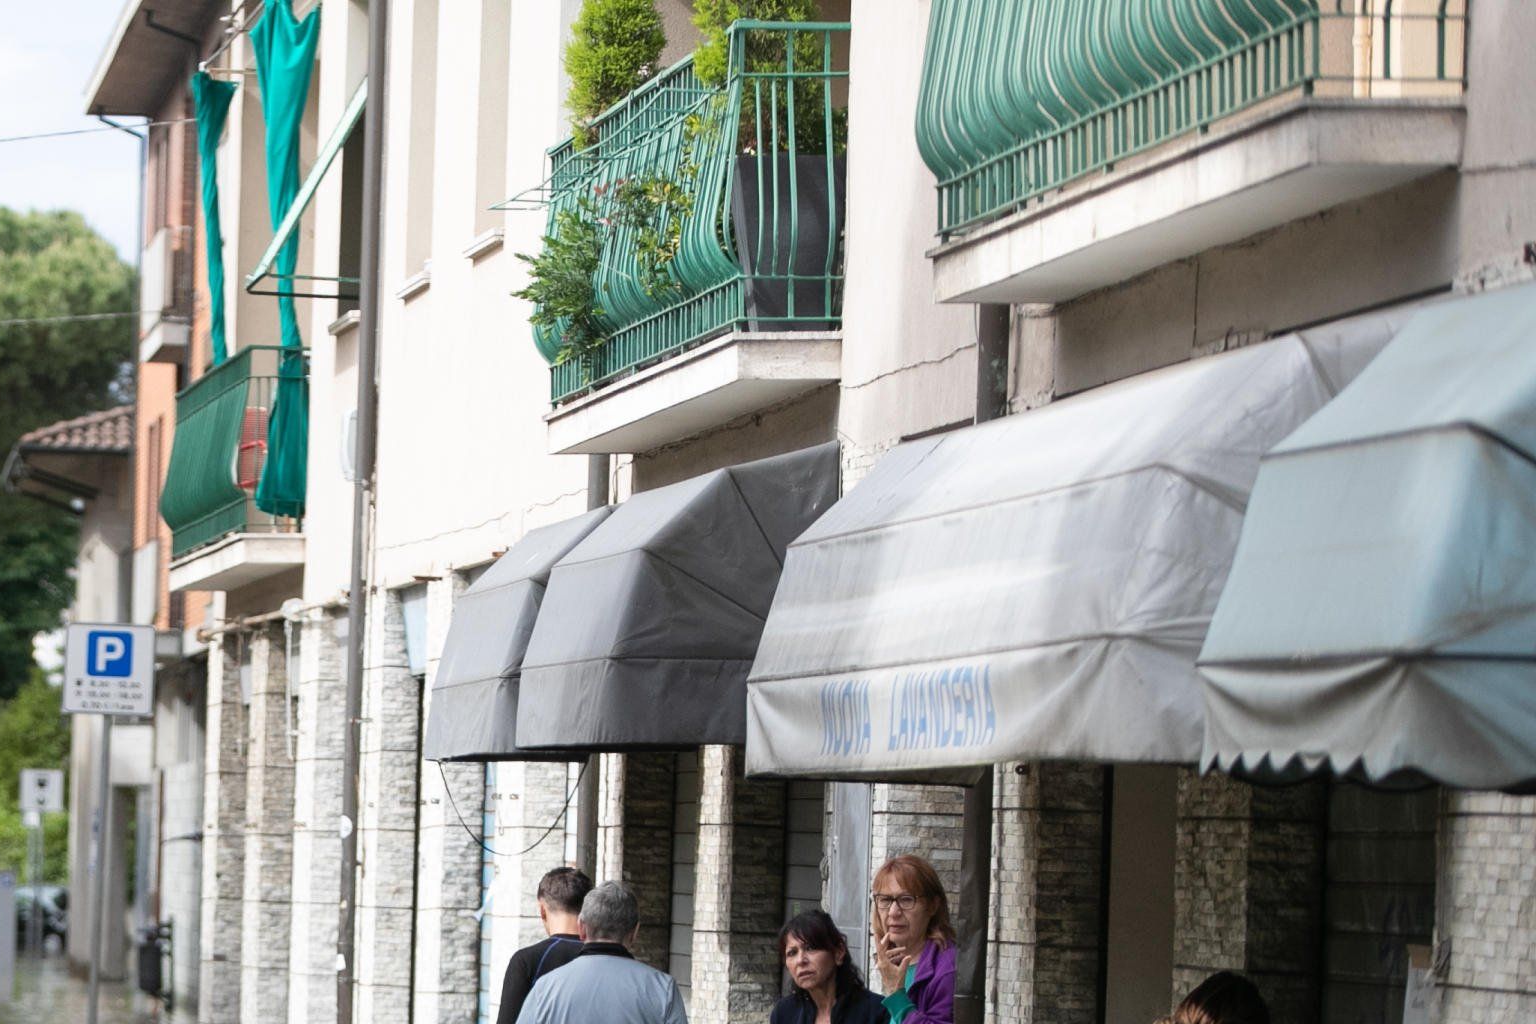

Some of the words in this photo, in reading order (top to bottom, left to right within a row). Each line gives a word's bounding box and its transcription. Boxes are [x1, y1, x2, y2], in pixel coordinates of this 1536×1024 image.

[96, 637, 126, 672] P
[821, 682, 871, 756] NUOVA
[888, 664, 996, 750] LAVANDERIA
